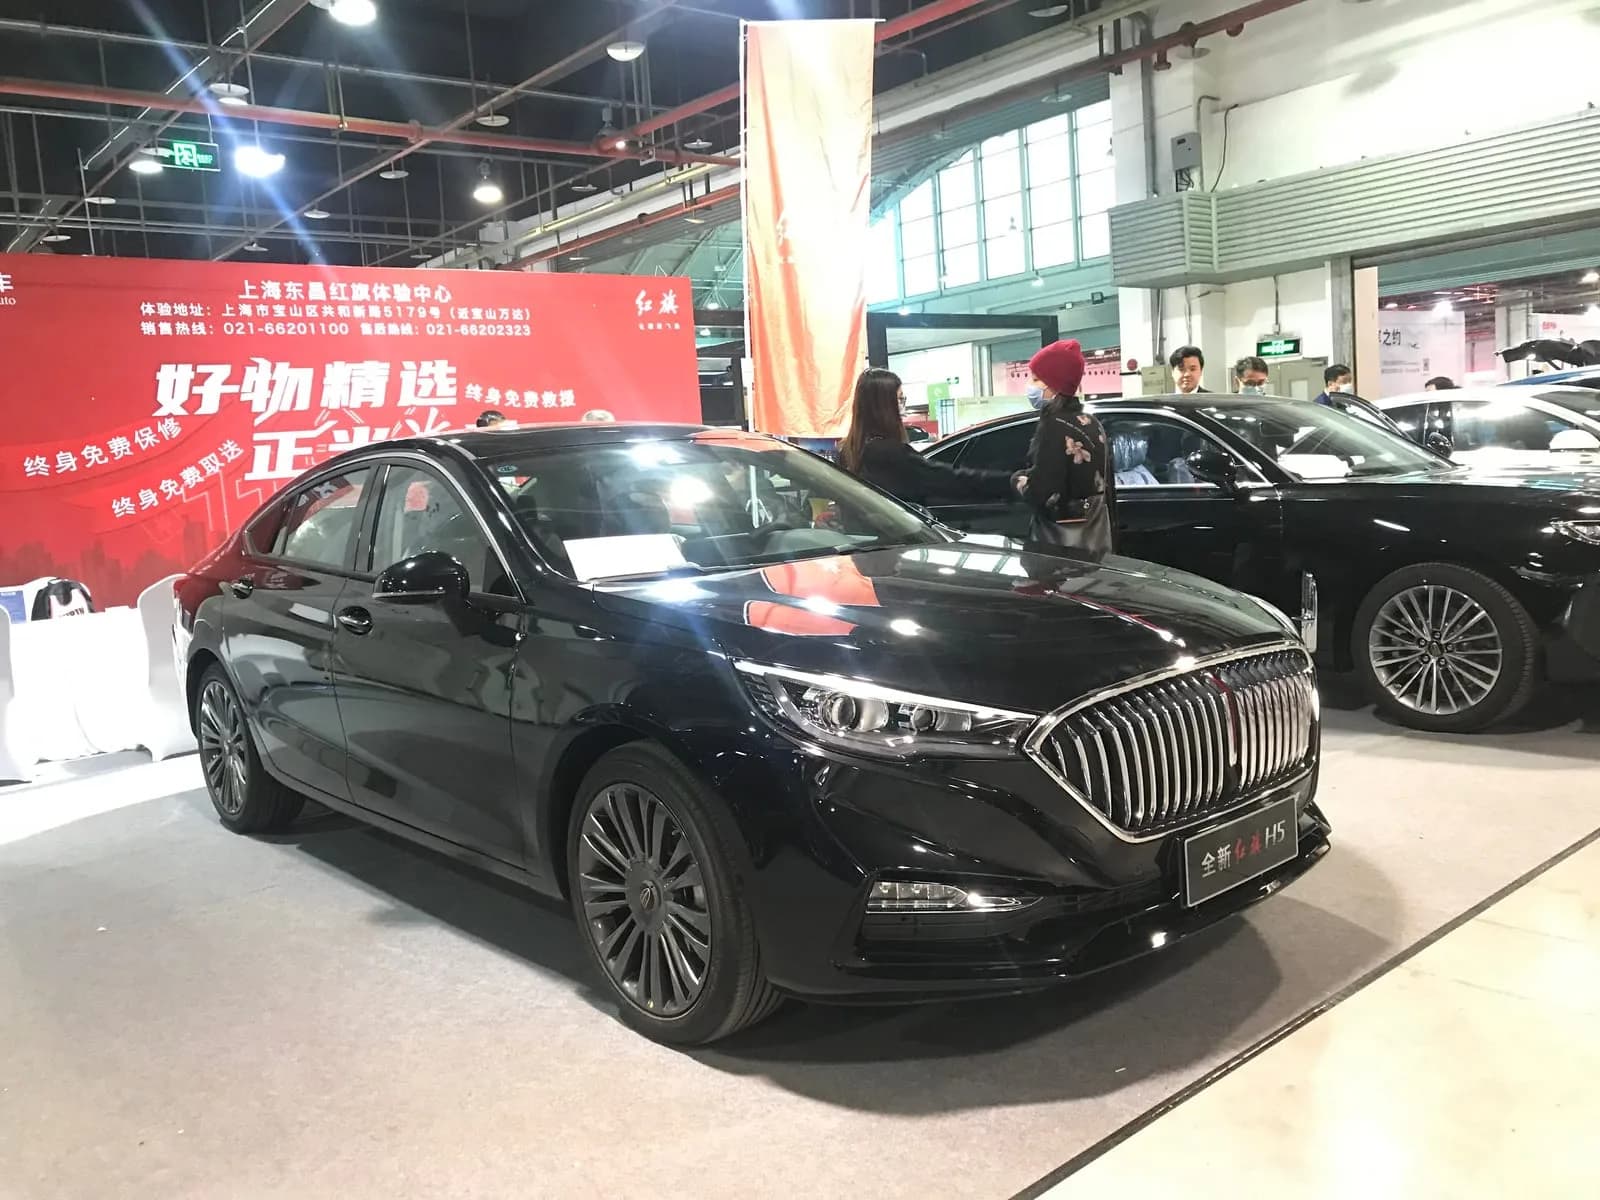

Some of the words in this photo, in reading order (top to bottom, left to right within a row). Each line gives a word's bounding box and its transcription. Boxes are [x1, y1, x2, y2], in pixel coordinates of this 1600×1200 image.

[238, 279, 452, 303] 上海东昌红旗体验中心
[152, 357, 457, 427] 好物精选
[465, 383, 576, 408] 终身免费救援
[23, 417, 182, 477] 终身免费保修
[111, 439, 244, 518] 终身免费取送
